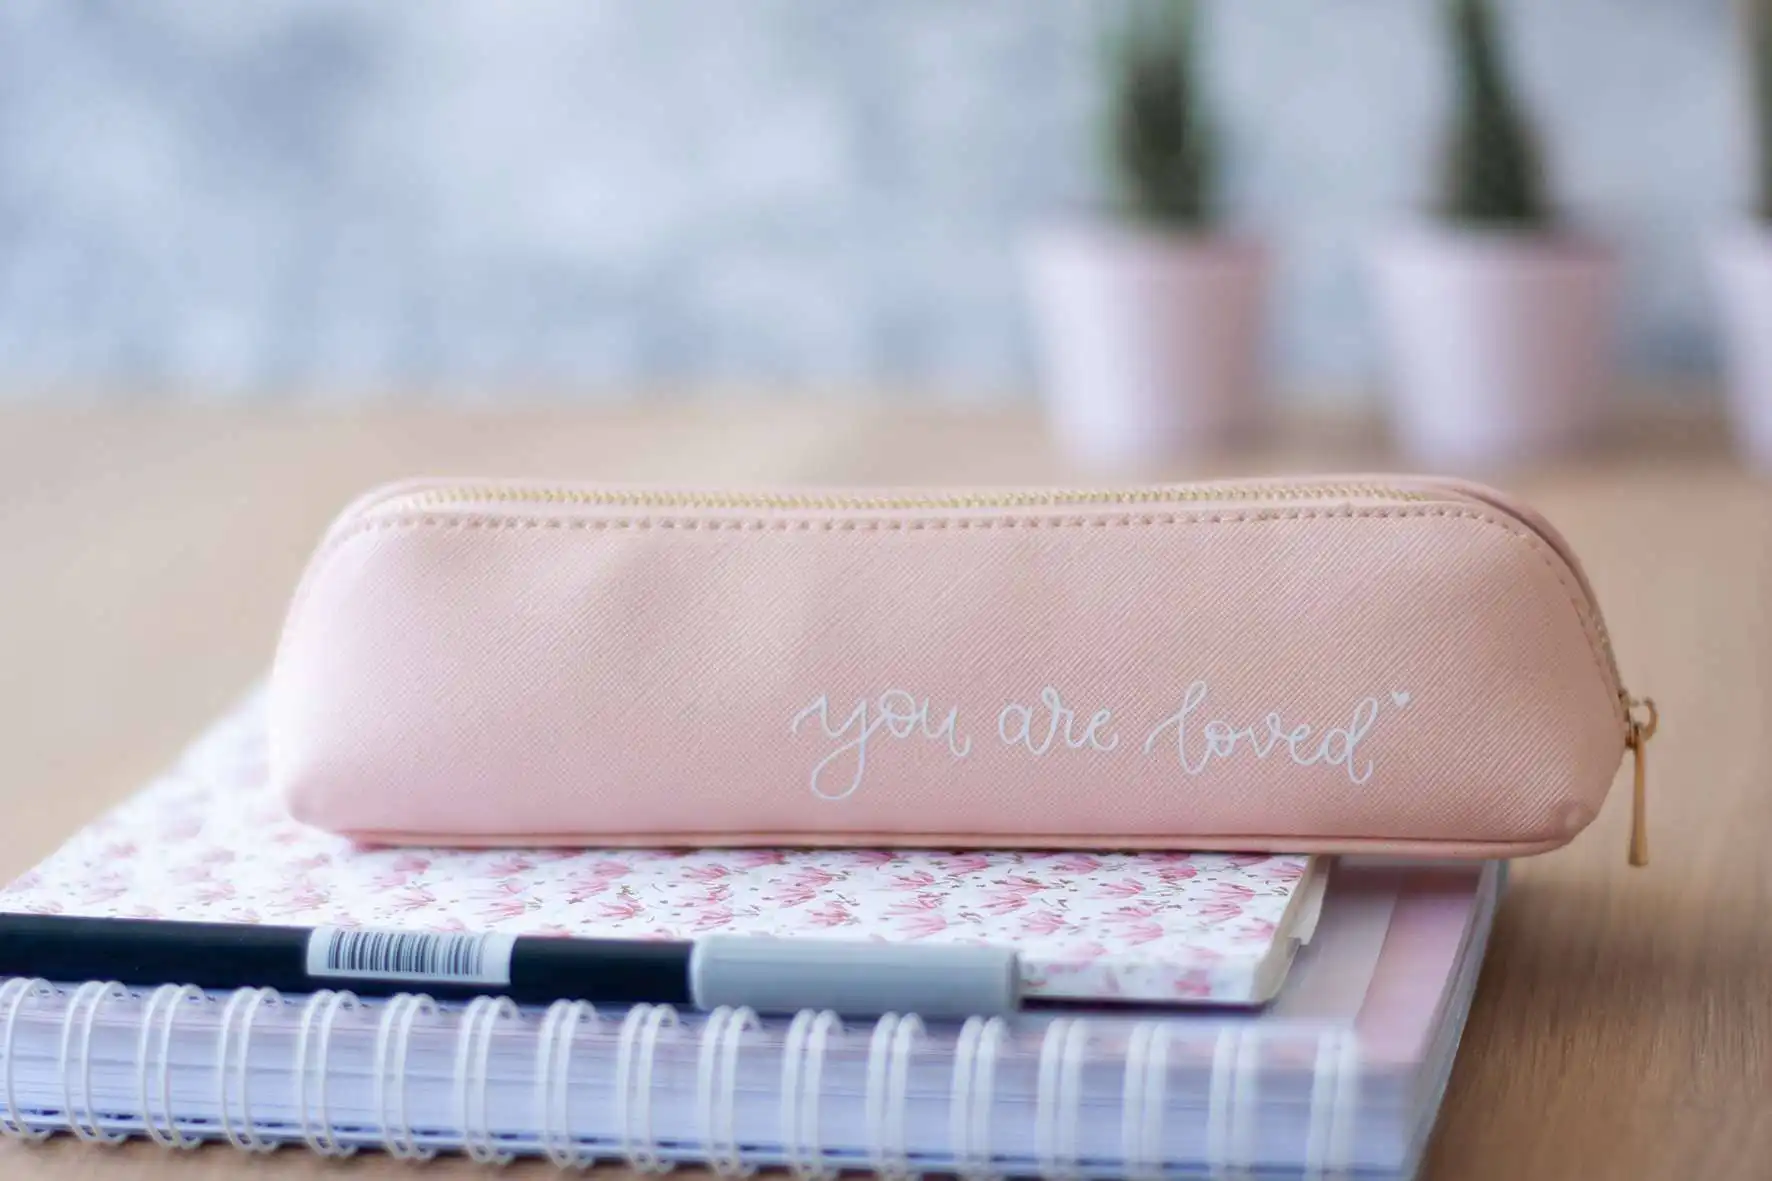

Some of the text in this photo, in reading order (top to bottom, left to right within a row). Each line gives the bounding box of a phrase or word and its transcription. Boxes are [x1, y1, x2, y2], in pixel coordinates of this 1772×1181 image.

[792, 680, 1379, 800] you are loved
